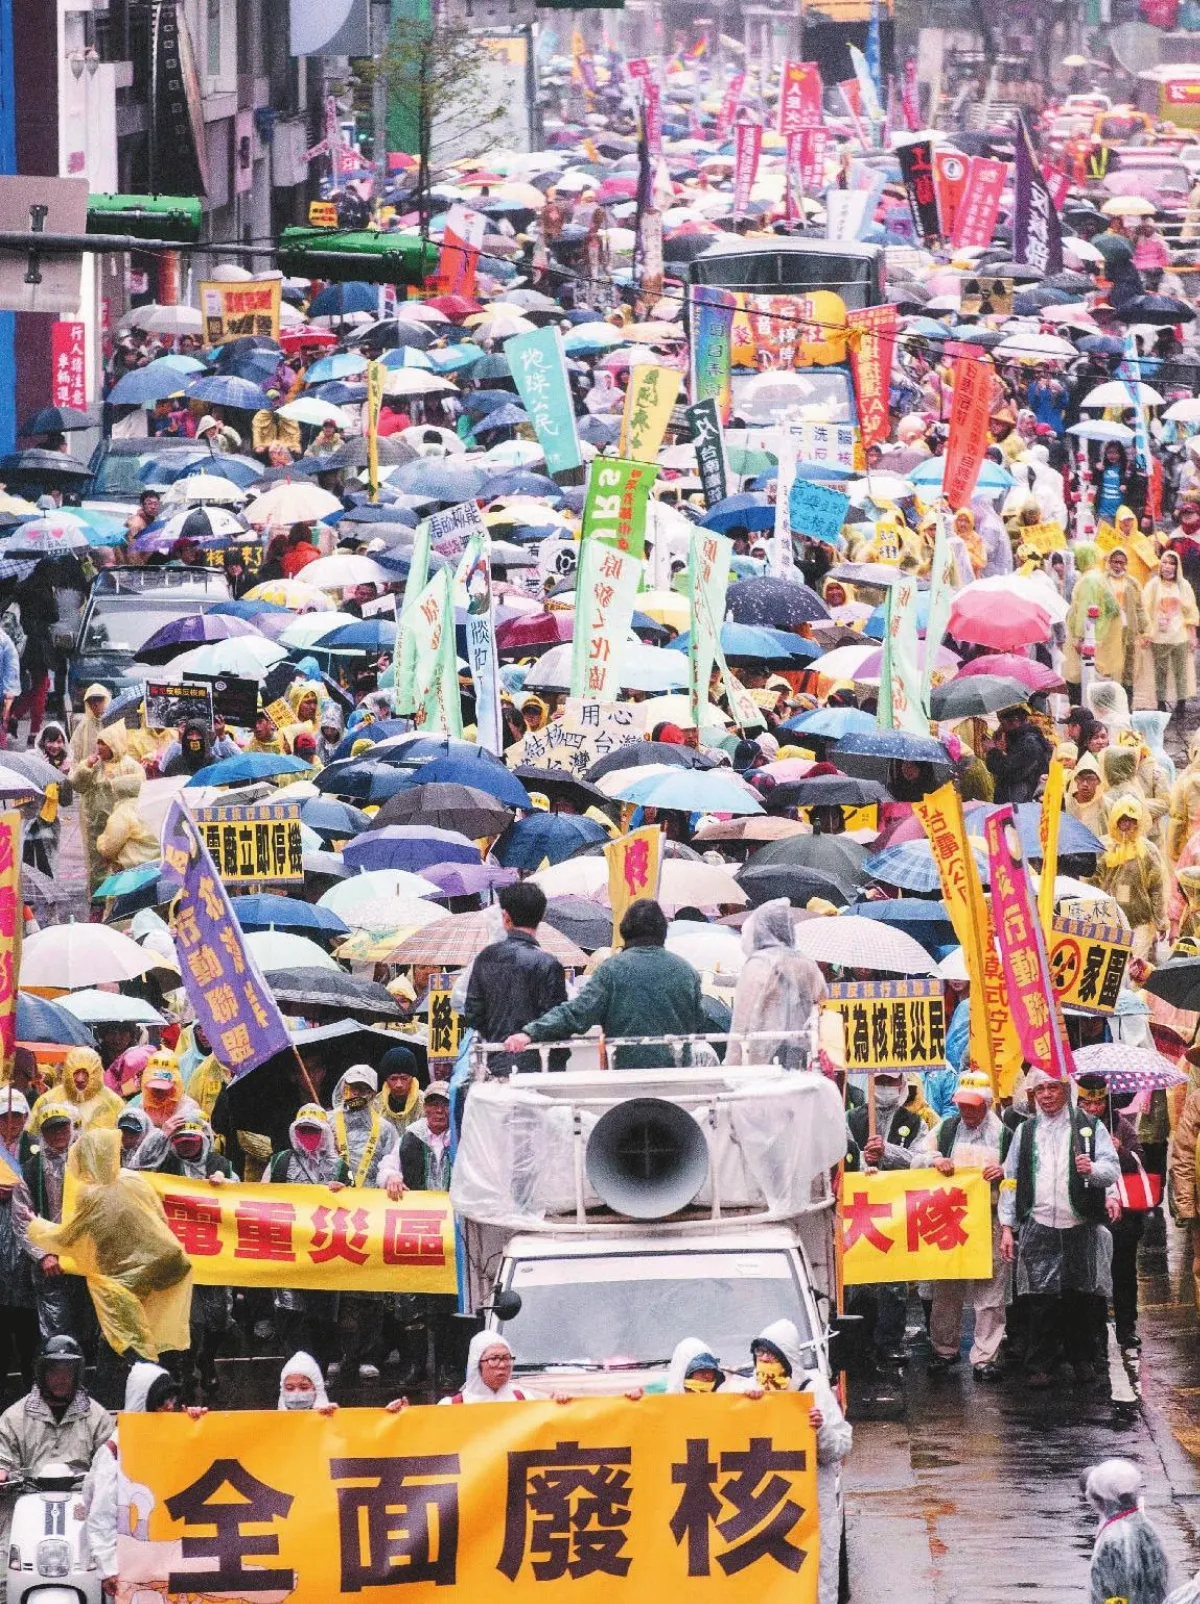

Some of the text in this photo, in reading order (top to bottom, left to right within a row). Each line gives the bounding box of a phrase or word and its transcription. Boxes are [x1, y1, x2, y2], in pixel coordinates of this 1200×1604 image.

[520, 348, 558, 436] 地球公民
[580, 704, 633, 727] 用心
[198, 822, 304, 877] 電廠立即停機
[1077, 944, 1130, 1009] 家園
[843, 1190, 969, 1254] 大隊
[164, 1437, 808, 1595] 全面廢核
